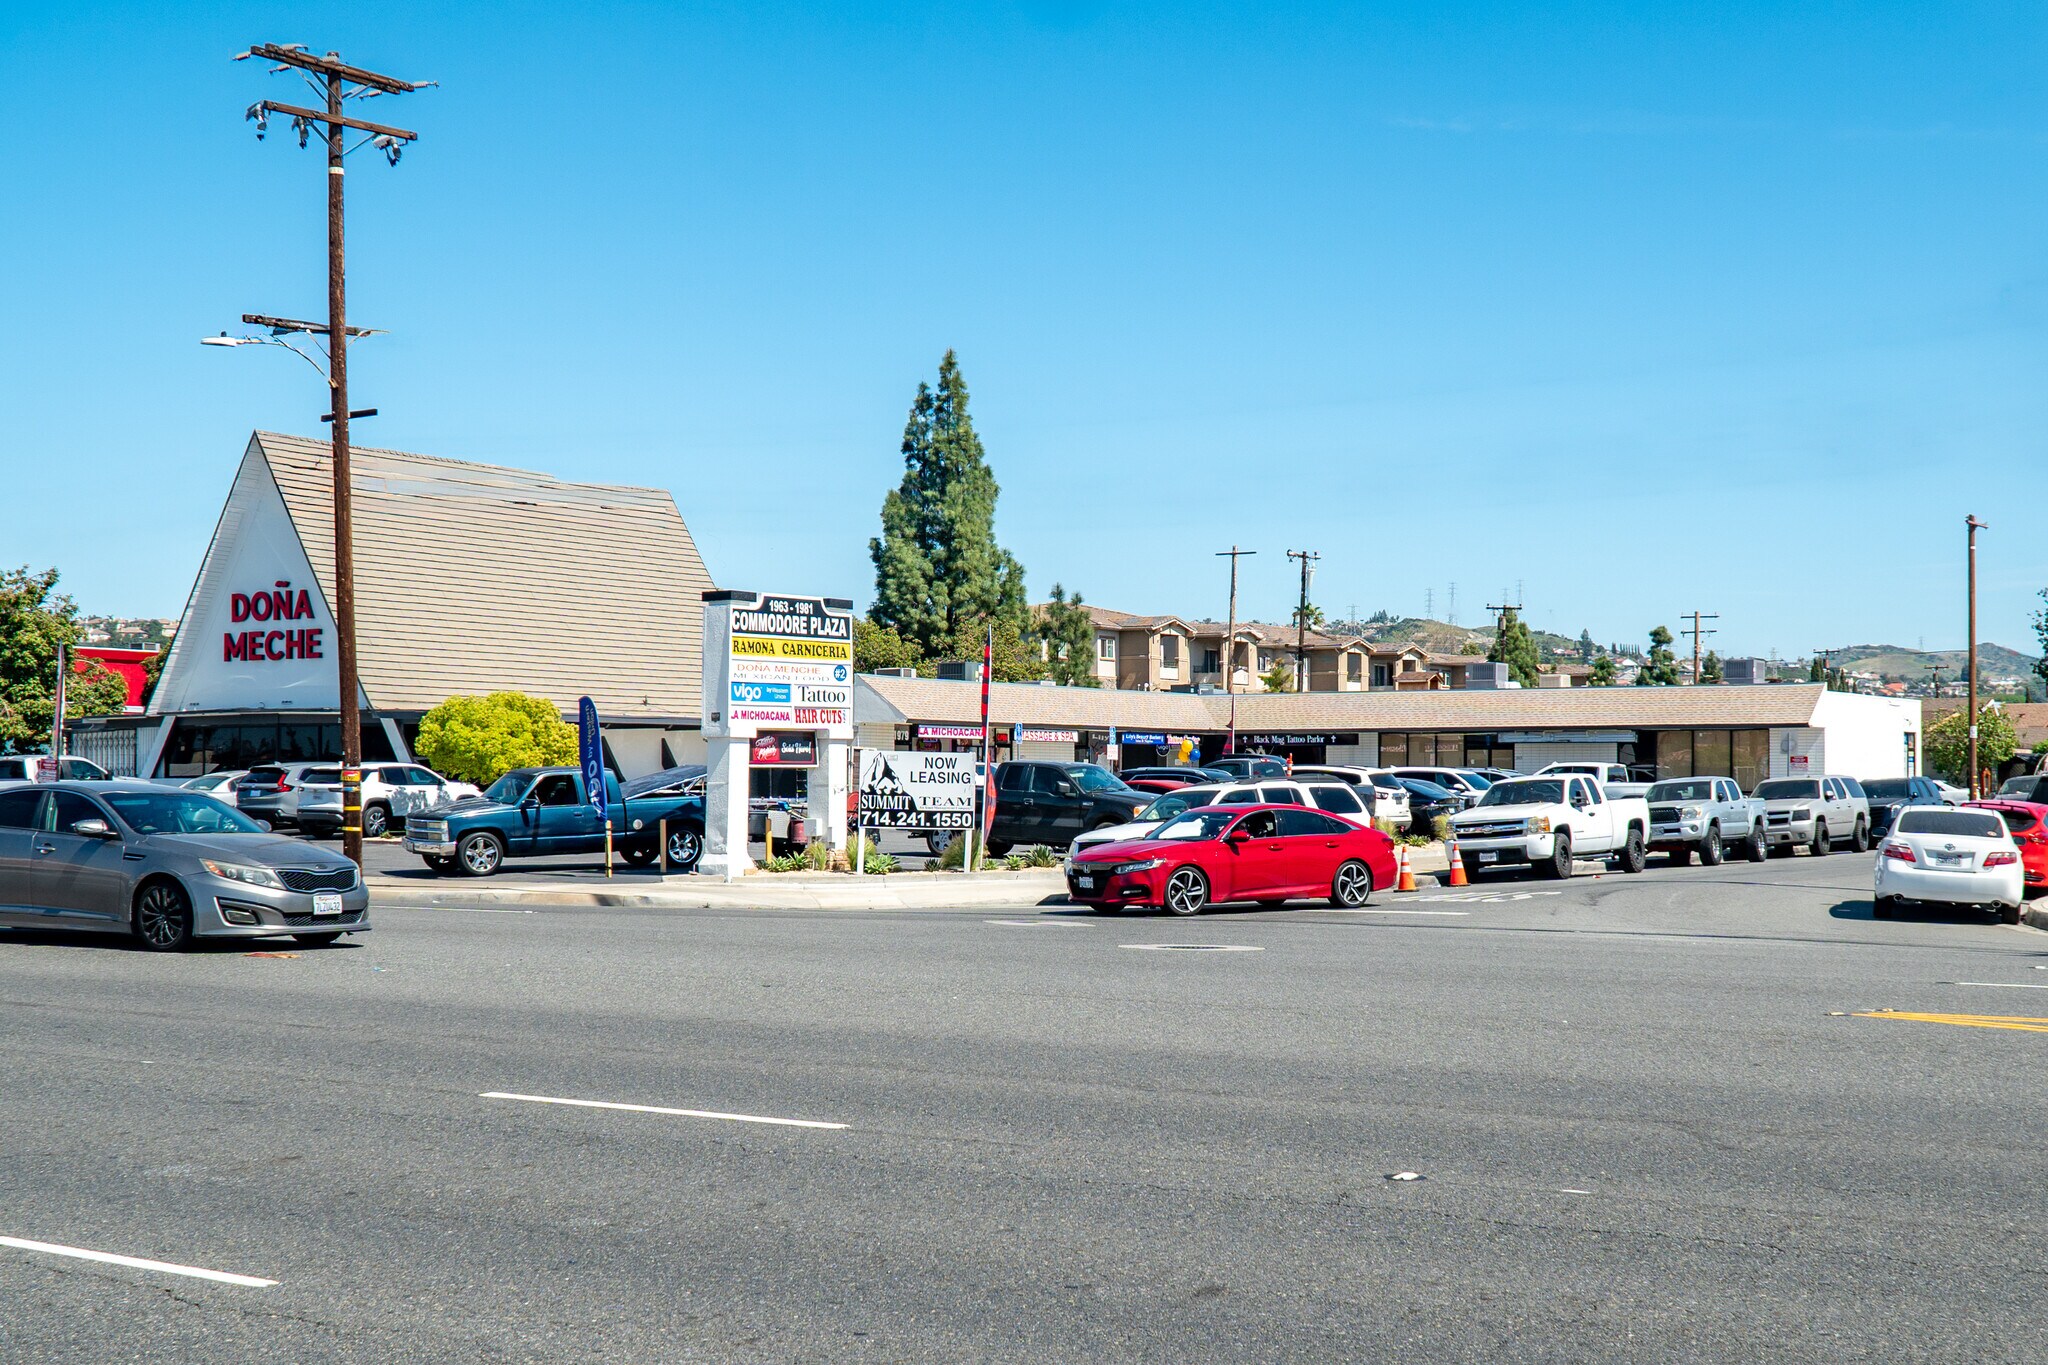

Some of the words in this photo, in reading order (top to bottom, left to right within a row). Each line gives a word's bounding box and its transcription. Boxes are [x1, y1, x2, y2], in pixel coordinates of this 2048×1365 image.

[231, 580, 315, 622] DOÑA
[769, 599, 789, 613] 1963
[795, 602, 813, 614] 1981
[732, 610, 808, 635] COMMODORE
[810, 616, 848, 637] PLAZA
[223, 628, 323, 662] MECHE
[733, 640, 775, 654] RAMONA
[782, 642, 848, 658] CARNICERIA
[737, 662, 771, 672] DOÑA
[774, 665, 821, 674] MENCHE
[834, 668, 846, 679] #2
[733, 683, 761, 701] vigo
[798, 685, 846, 703] Tattoo
[740, 710, 791, 721] MICHOACANA
[794, 708, 819, 724] HAIR
[820, 709, 842, 724] CUTS
[1060, 731, 1074, 741] SPA
[1253, 735, 1270, 744] Black
[1271, 735, 1285, 745] Mag
[1286, 735, 1306, 744] Tattoo
[1306, 735, 1325, 744] Parlor
[924, 756, 958, 769] NOW
[910, 771, 971, 784] LEASING
[861, 794, 912, 810] SUMMIT
[919, 796, 972, 807] TEAM
[861, 811, 972, 827] 714.241.1550
